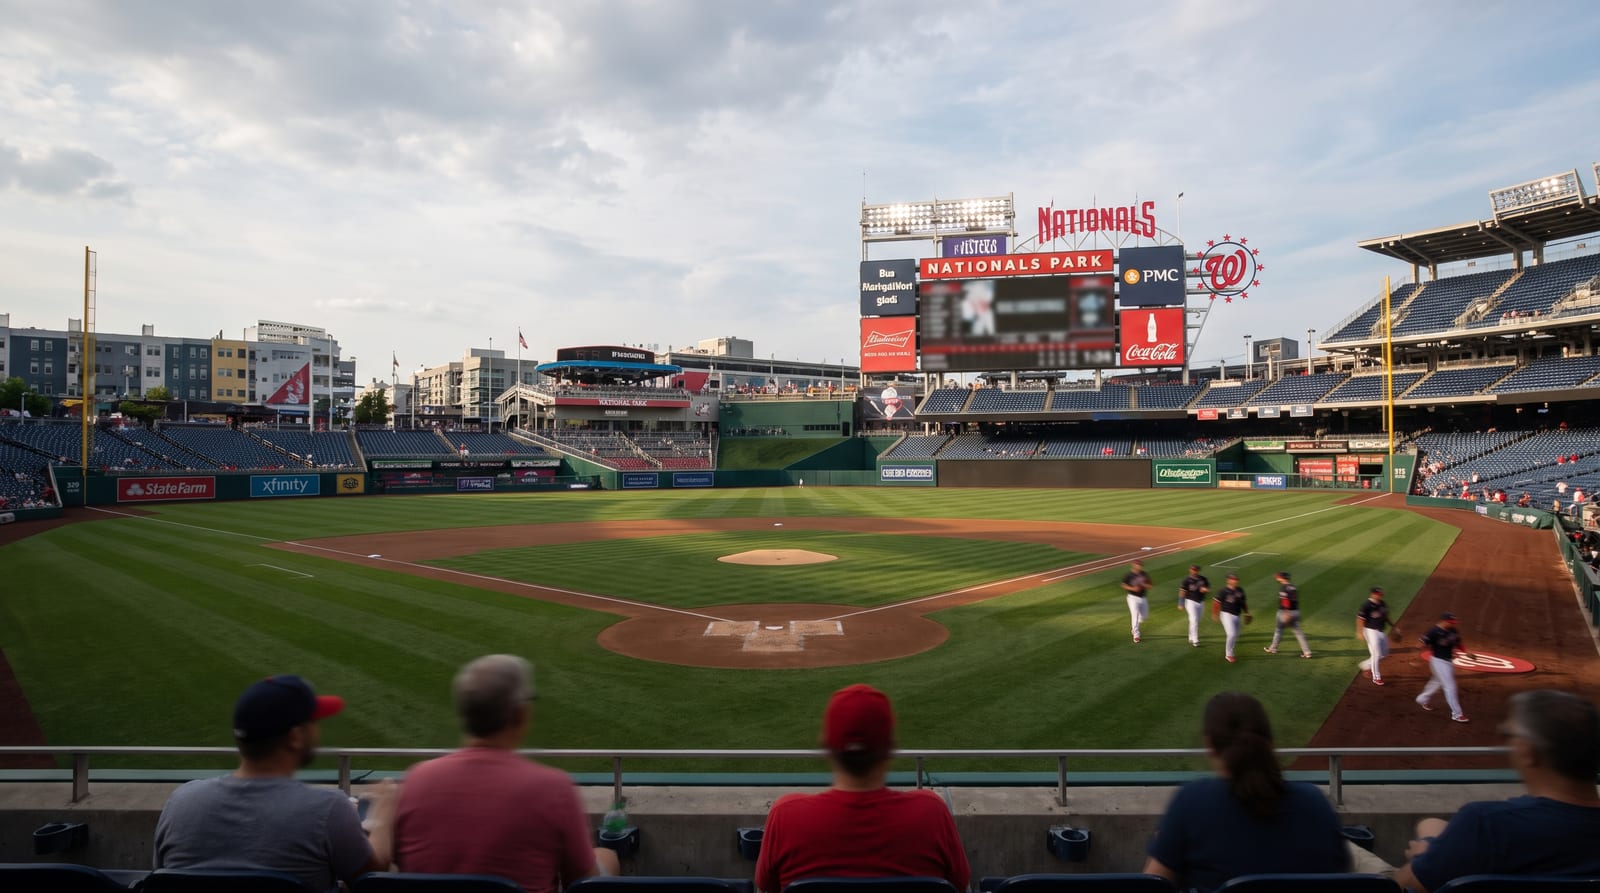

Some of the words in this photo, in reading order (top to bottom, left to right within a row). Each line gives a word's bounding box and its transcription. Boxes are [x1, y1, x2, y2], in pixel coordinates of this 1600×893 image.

[1038, 201, 1156, 244] NATIONALS
[928, 258, 1040, 274] NATIONALS
[1050, 255, 1102, 269] PARK
[1143, 268, 1179, 282] PMC
[263, 478, 308, 494] xfinity
